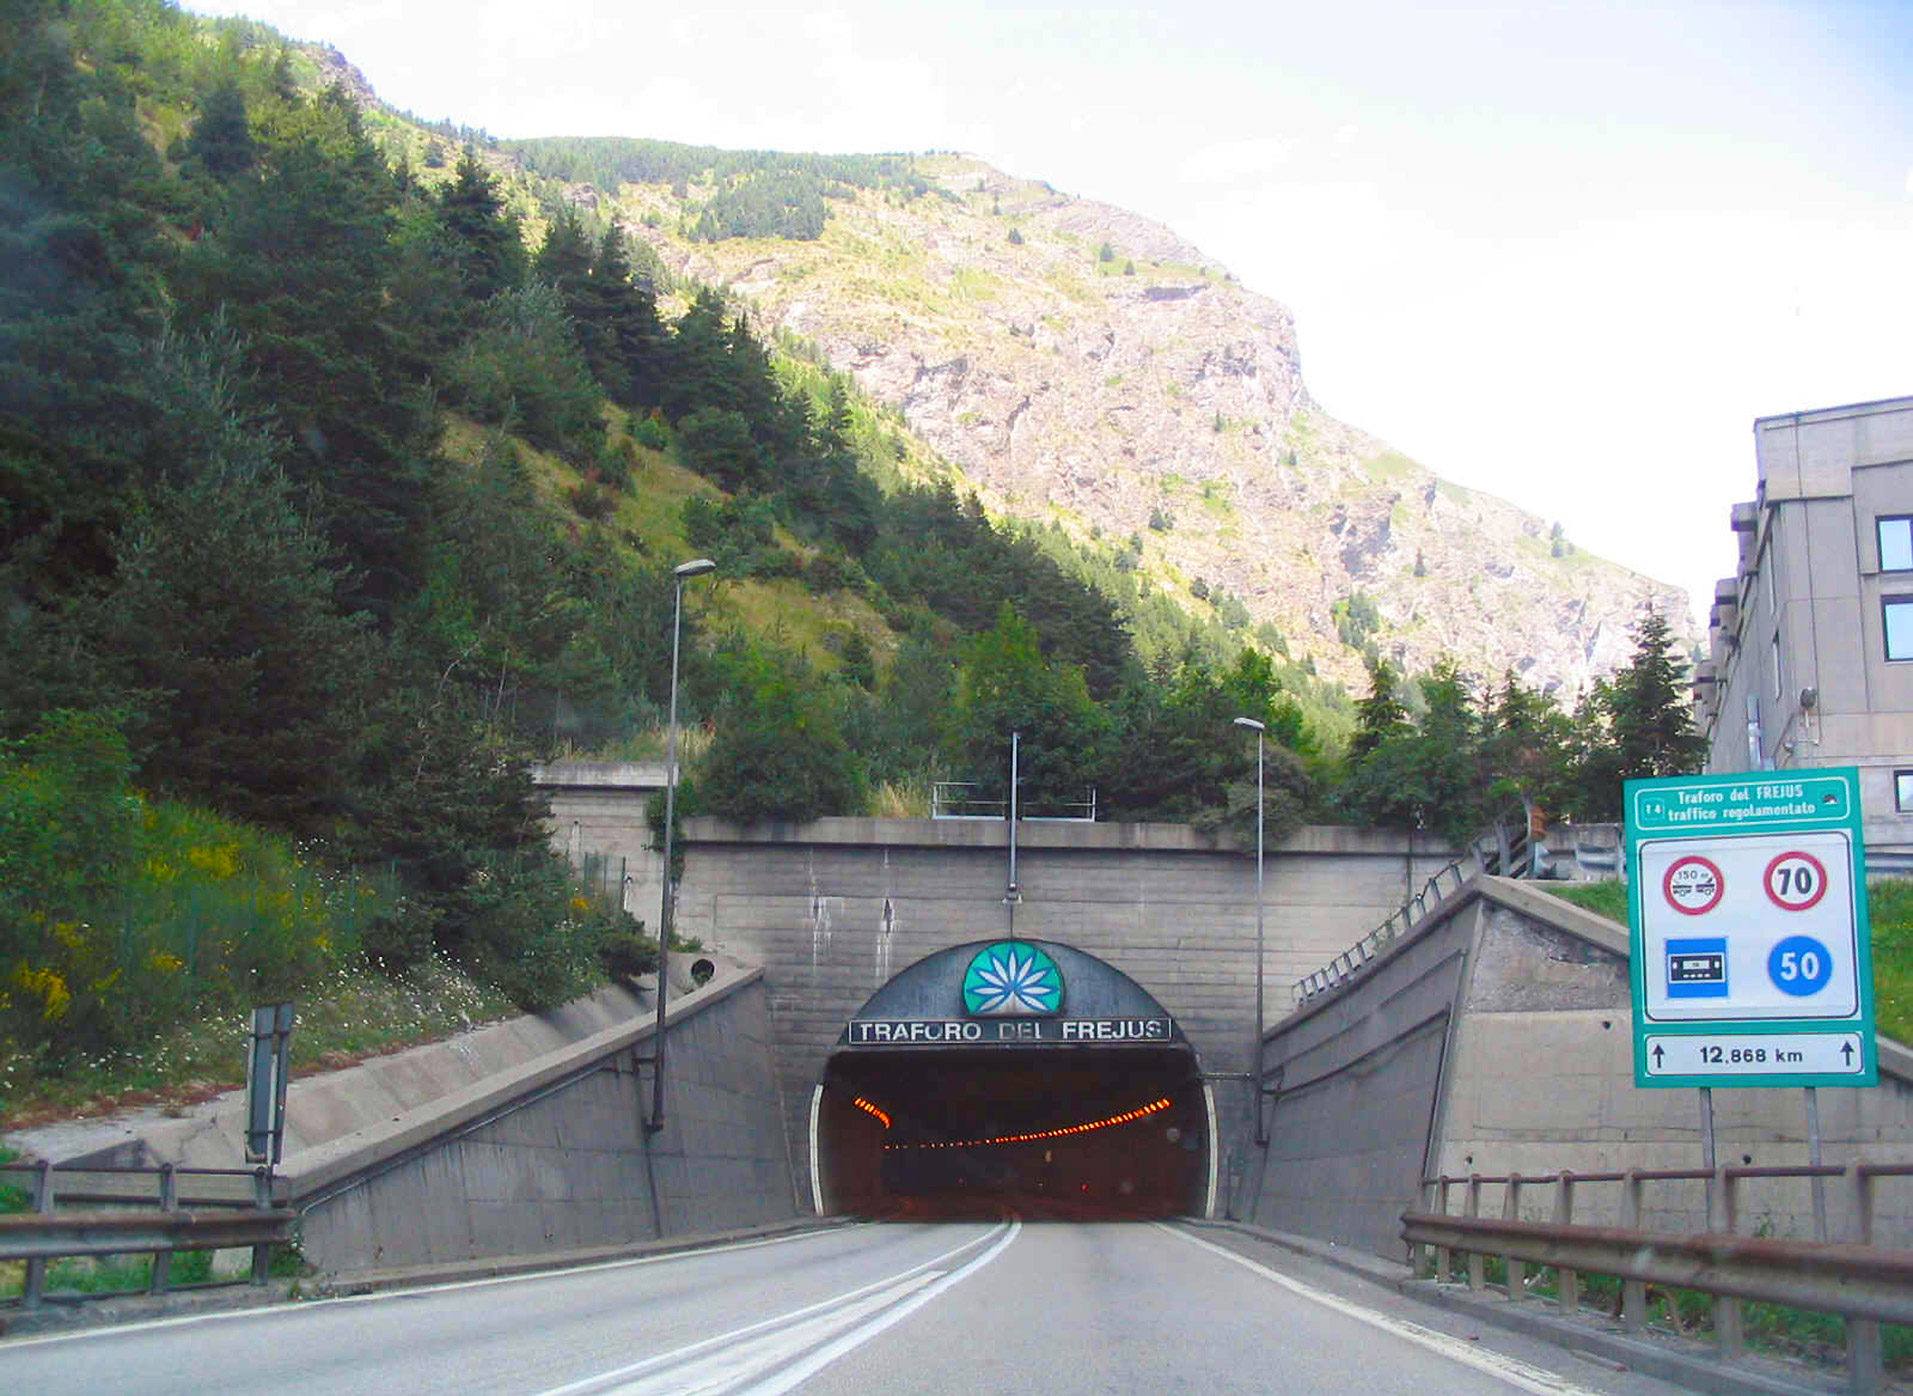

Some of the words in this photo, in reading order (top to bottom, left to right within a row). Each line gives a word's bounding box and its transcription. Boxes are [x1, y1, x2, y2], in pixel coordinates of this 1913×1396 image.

[1678, 789, 1724, 804] Traforo
[1730, 789, 1751, 801] del
[1756, 784, 1803, 799] FREJUS
[1668, 807, 1716, 822] traffico
[1723, 802, 1816, 821] regolamentato
[1678, 870, 1698, 880] 150
[1777, 867, 1812, 896] 70
[1780, 951, 1820, 981] 50
[860, 1022, 982, 1041] TRAFORO
[999, 1022, 1043, 1041] DEL
[1062, 1021, 1162, 1040] FREJUS
[1776, 1049, 1803, 1063] km
